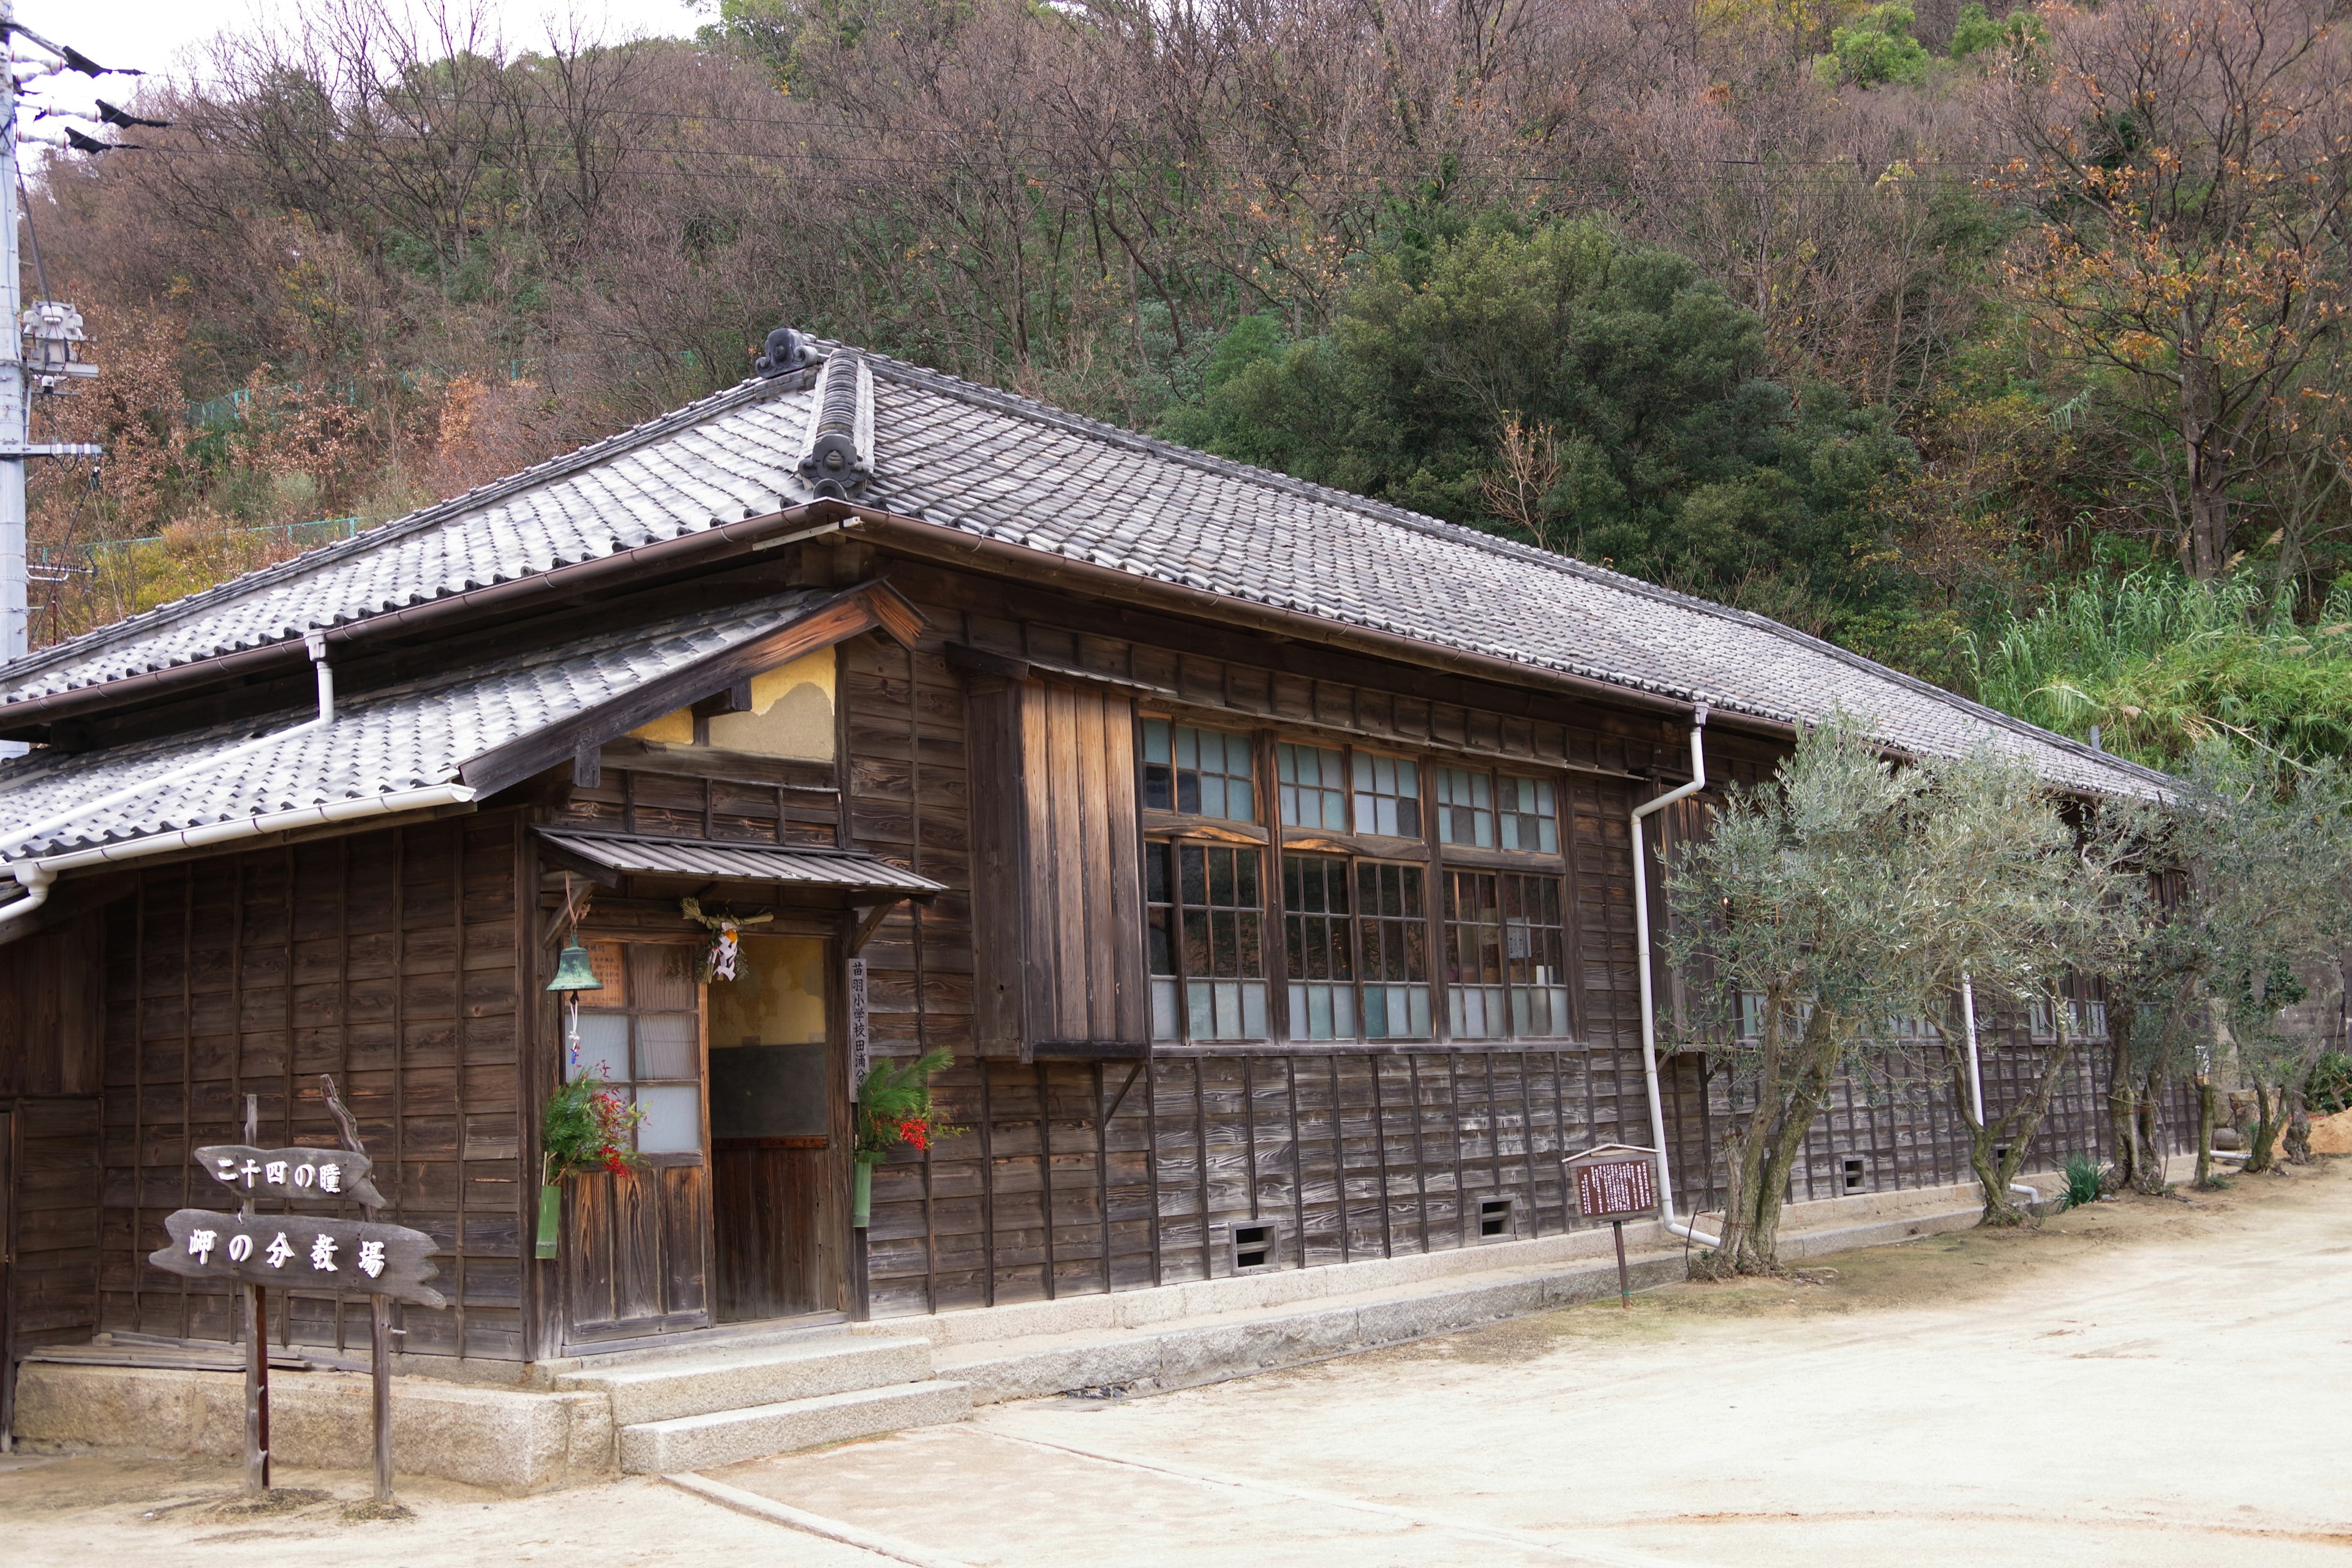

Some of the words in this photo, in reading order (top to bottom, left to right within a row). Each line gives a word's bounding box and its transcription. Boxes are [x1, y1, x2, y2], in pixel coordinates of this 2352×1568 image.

[217, 1159, 341, 1193] 二十四の瞳
[189, 1229, 385, 1278] 岬の分教場
